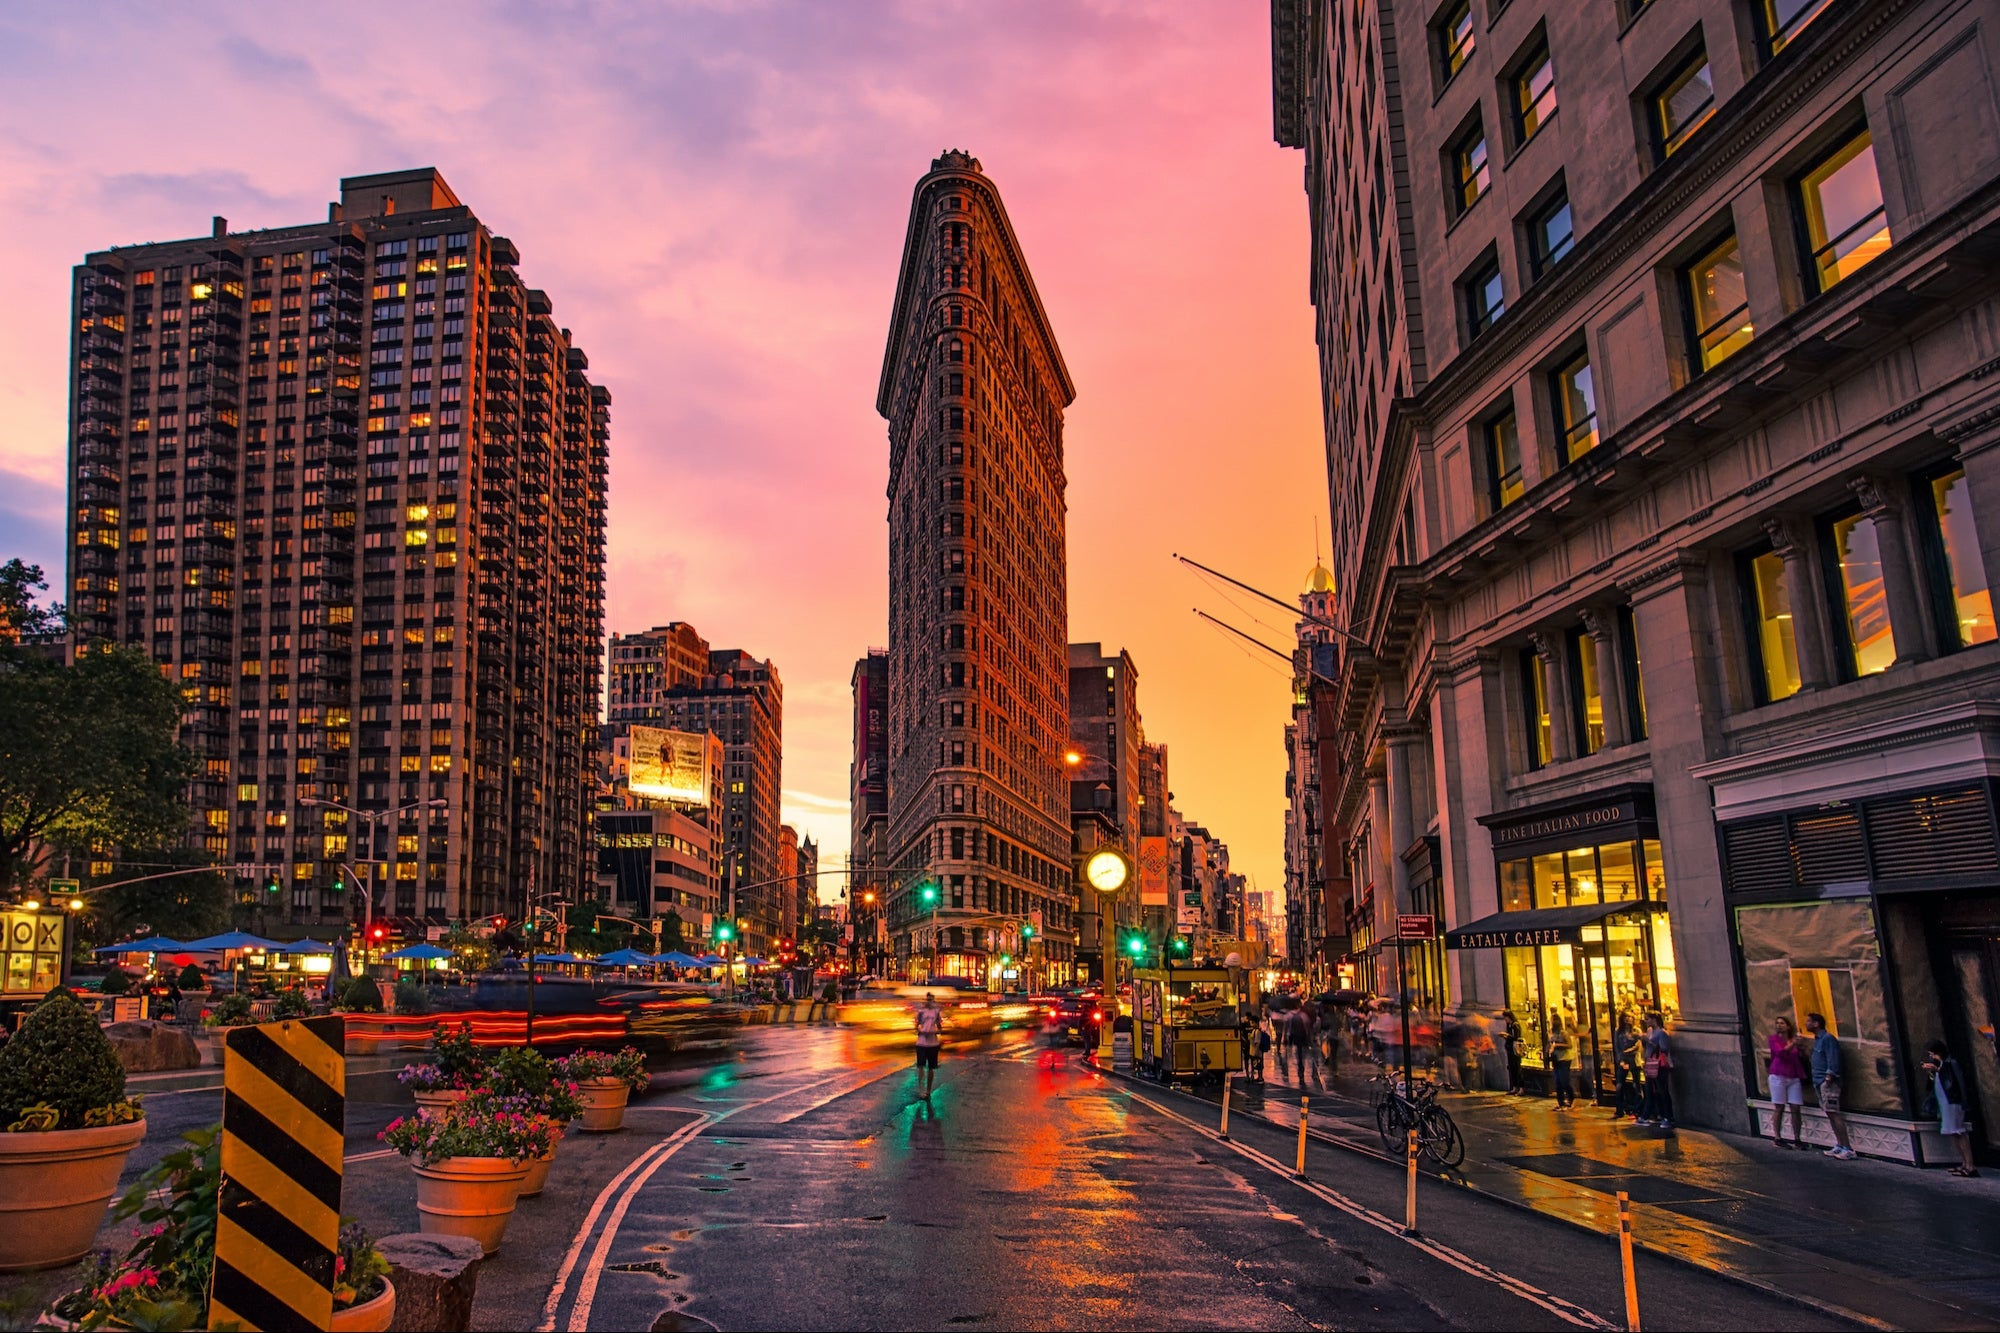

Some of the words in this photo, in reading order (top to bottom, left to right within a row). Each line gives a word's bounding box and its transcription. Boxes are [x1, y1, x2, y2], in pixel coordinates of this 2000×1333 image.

[1501, 825, 1527, 841] FINE
[1530, 815, 1580, 836] ITALIAN
[1585, 806, 1620, 825] FOOD
[0, 921, 58, 945] OX
[1460, 932, 1508, 948] EATALY
[1515, 929, 1561, 945] CAFFE
